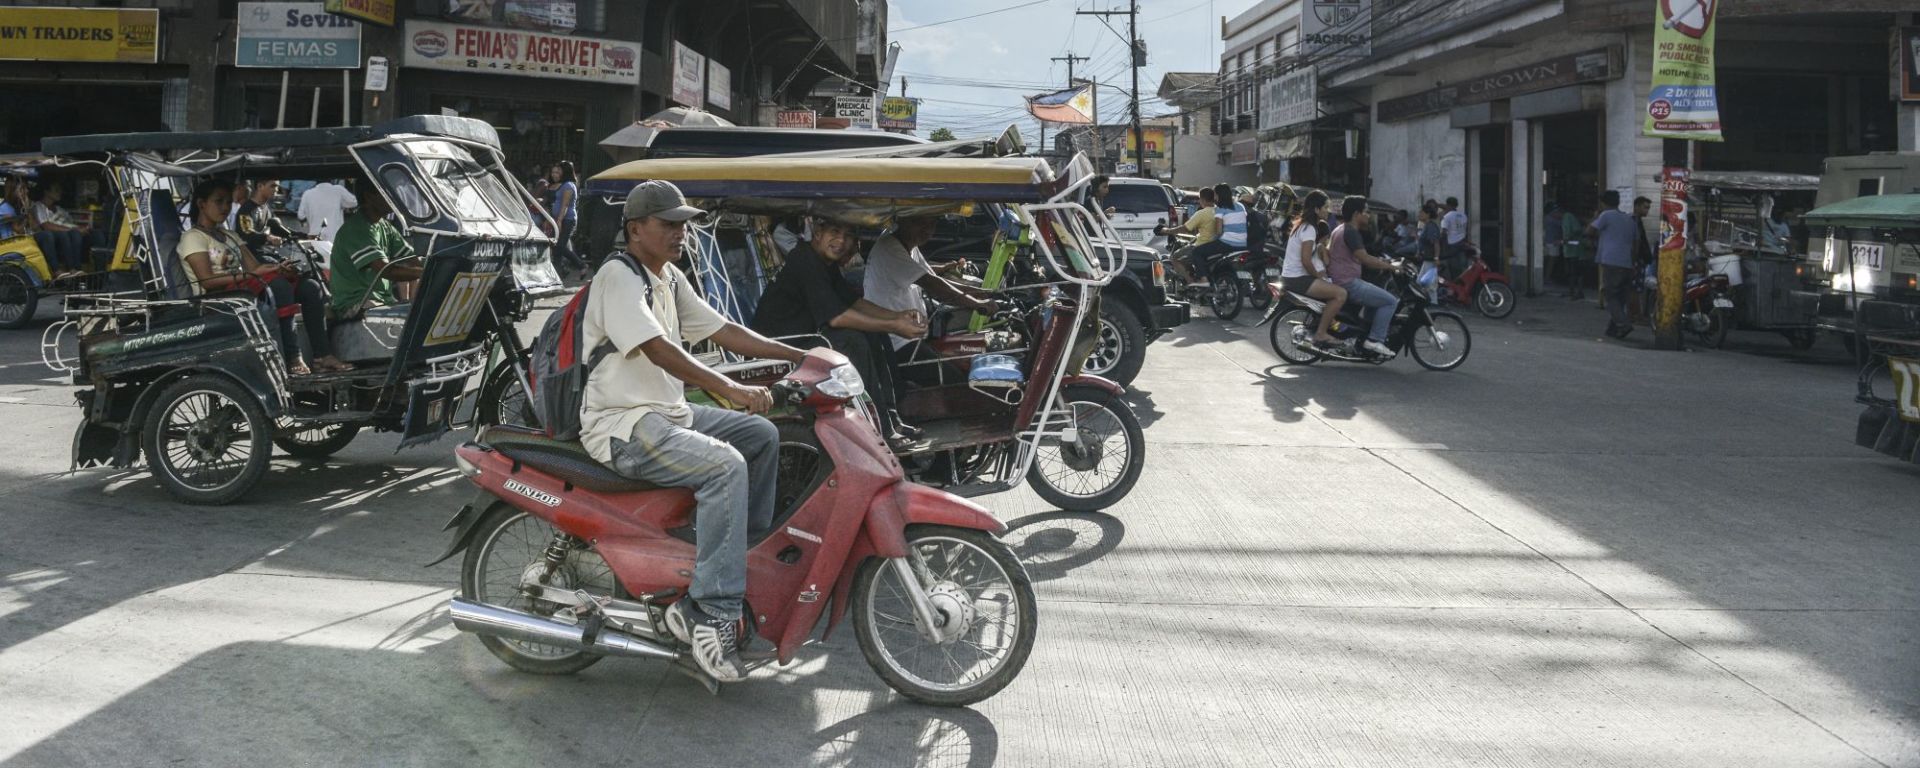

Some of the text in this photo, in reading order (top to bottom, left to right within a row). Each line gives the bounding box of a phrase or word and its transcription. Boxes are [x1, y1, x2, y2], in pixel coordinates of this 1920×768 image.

[33, 27, 113, 41] TRADERS
[1305, 33, 1366, 44] PACIFICA
[257, 42, 337, 56] FEMAS
[455, 28, 600, 67] FEMA'S AGRIVET
[1659, 42, 1674, 50] NO
[1660, 51, 1694, 61] PUBLIC
[1470, 63, 1557, 94] CROWN
[1665, 88, 1674, 97] 2
[778, 112, 813, 123] SALLY'S
[473, 242, 506, 257] DOMAY
[506, 480, 561, 506] DUNLOP
